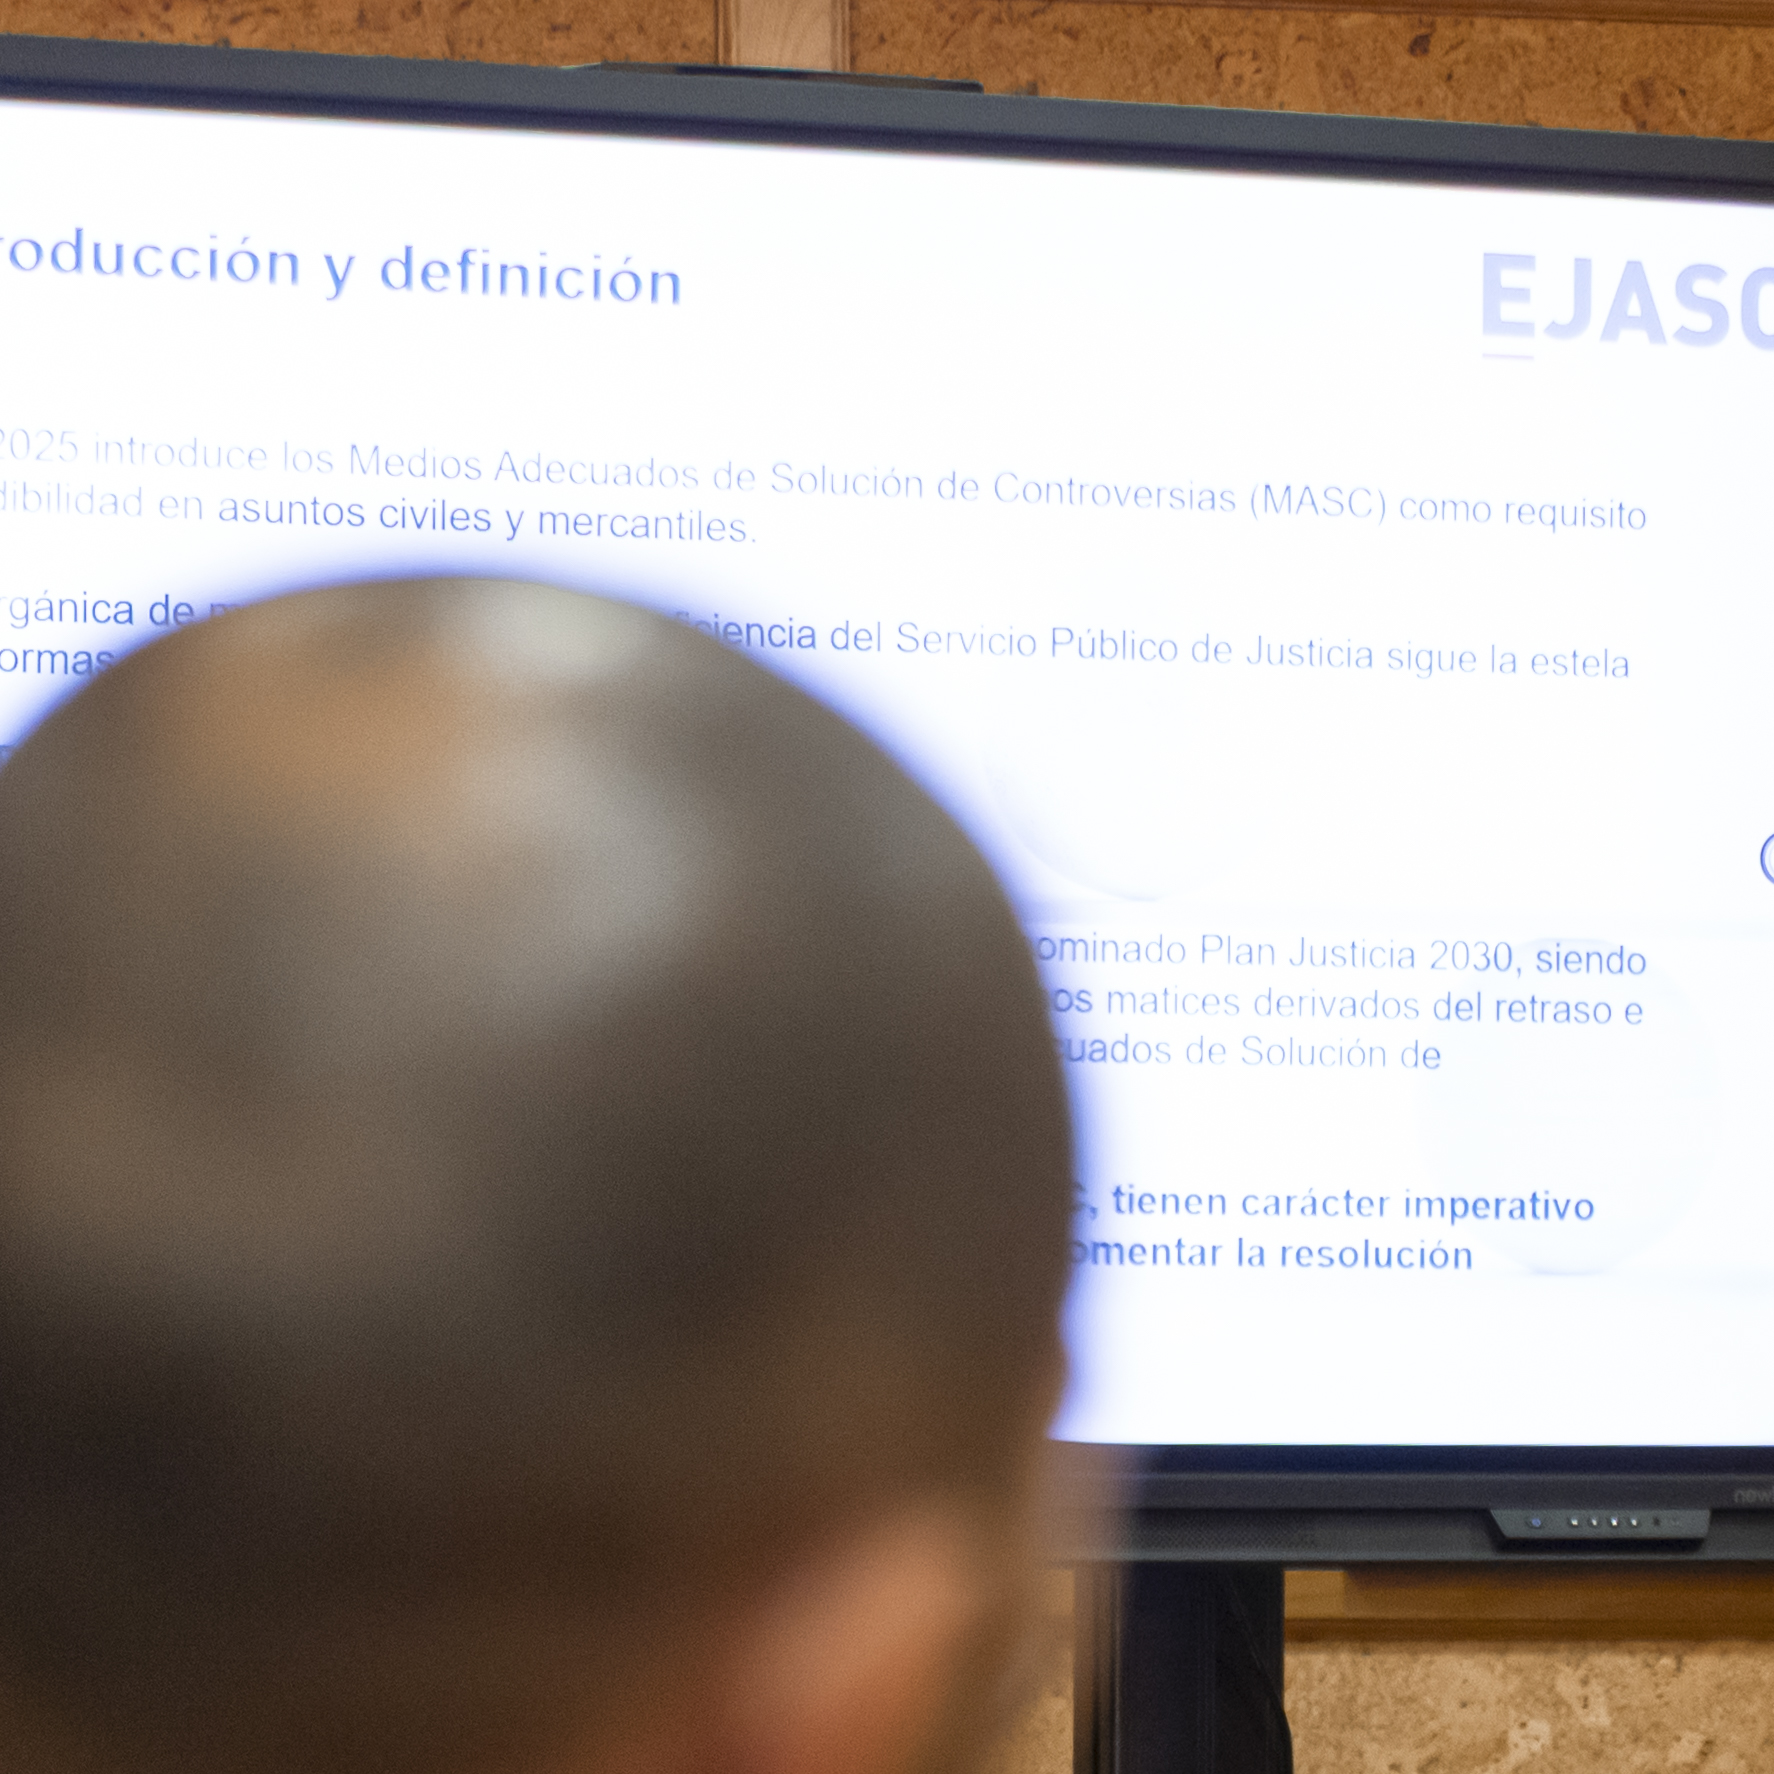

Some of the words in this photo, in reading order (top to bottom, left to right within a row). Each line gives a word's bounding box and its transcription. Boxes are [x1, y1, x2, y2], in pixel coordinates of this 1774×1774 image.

[0, 227, 298, 285] oducción
[324, 255, 355, 300] y
[381, 245, 680, 304] definición
[0, 428, 78, 461] 025
[96, 436, 267, 469] introduce
[284, 441, 334, 473] los
[350, 444, 482, 480] Medios
[494, 450, 698, 488] Adecuados
[713, 461, 755, 490] de
[771, 462, 923, 498] Solución
[937, 470, 979, 500] de
[994, 472, 1236, 511] Controversias
[1250, 483, 1386, 523] (MASC)
[1400, 498, 1491, 522] como
[1506, 502, 1646, 533] requisito
[159, 496, 202, 520] en
[219, 497, 365, 527] asuntos
[380, 499, 491, 532] civiles
[506, 510, 524, 541] y
[539, 511, 757, 543] mercantiles.
[0, 589, 134, 629] gánica
[150, 594, 198, 631] de
[830, 620, 880, 651] del
[897, 622, 1036, 656] Servicio
[1052, 627, 1178, 661] Público
[1192, 633, 1232, 663] de
[1246, 635, 1373, 668] Justicia
[1388, 648, 1477, 678] sigue
[1491, 644, 1517, 673] la
[1531, 648, 1629, 678] estela
[1202, 934, 1275, 965] Plan
[1289, 937, 1415, 968] Justicia
[1431, 941, 1521, 978] 2030,
[1536, 942, 1646, 975] siendo
[1107, 987, 1240, 1015] matices
[1254, 987, 1419, 1019] derivados
[1433, 991, 1481, 1021] del
[1496, 995, 1612, 1024] retraso
[1625, 1002, 1643, 1025] e
[1060, 1034, 1172, 1065] uados
[1186, 1035, 1226, 1063] de
[1242, 1035, 1386, 1067] Solución
[1401, 1040, 1441, 1070] de
[1112, 1184, 1227, 1215] tienen
[1242, 1188, 1389, 1217] carácter
[1405, 1191, 1594, 1225] imperativo
[1238, 1237, 1264, 1266] la
[1281, 1239, 1472, 1269] resolución
